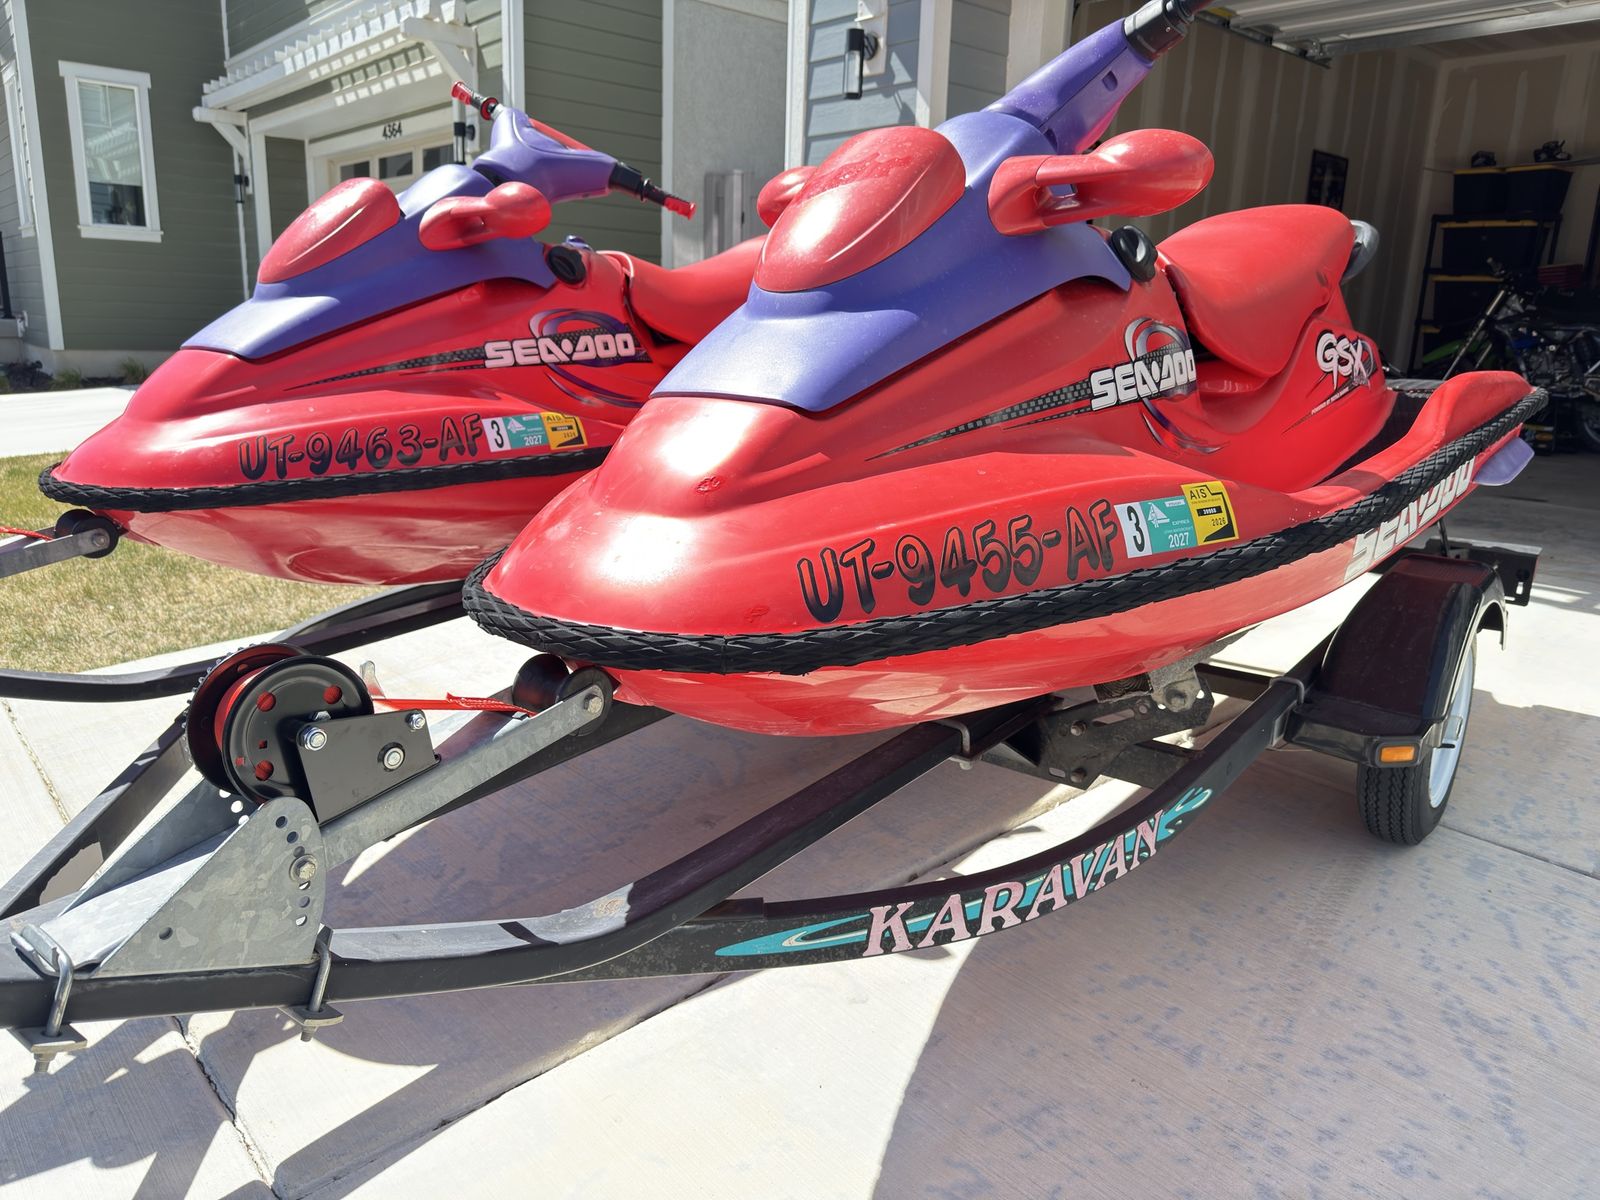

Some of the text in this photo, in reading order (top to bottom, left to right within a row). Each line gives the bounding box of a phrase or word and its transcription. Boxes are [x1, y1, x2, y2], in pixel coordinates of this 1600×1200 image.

[383, 121, 402, 139] 4364
[1316, 331, 1369, 390] GSX
[239, 413, 483, 480] UT-9463-AF
[490, 420, 504, 448] 3
[524, 435, 543, 446] 2027
[1190, 488, 1207, 500] AIS
[1126, 505, 1145, 552] 3
[1212, 517, 1226, 527] 2026
[1168, 532, 1189, 548] 2027
[797, 498, 1117, 624] UT-9455-AF
[862, 809, 1164, 956] KARAVAN
